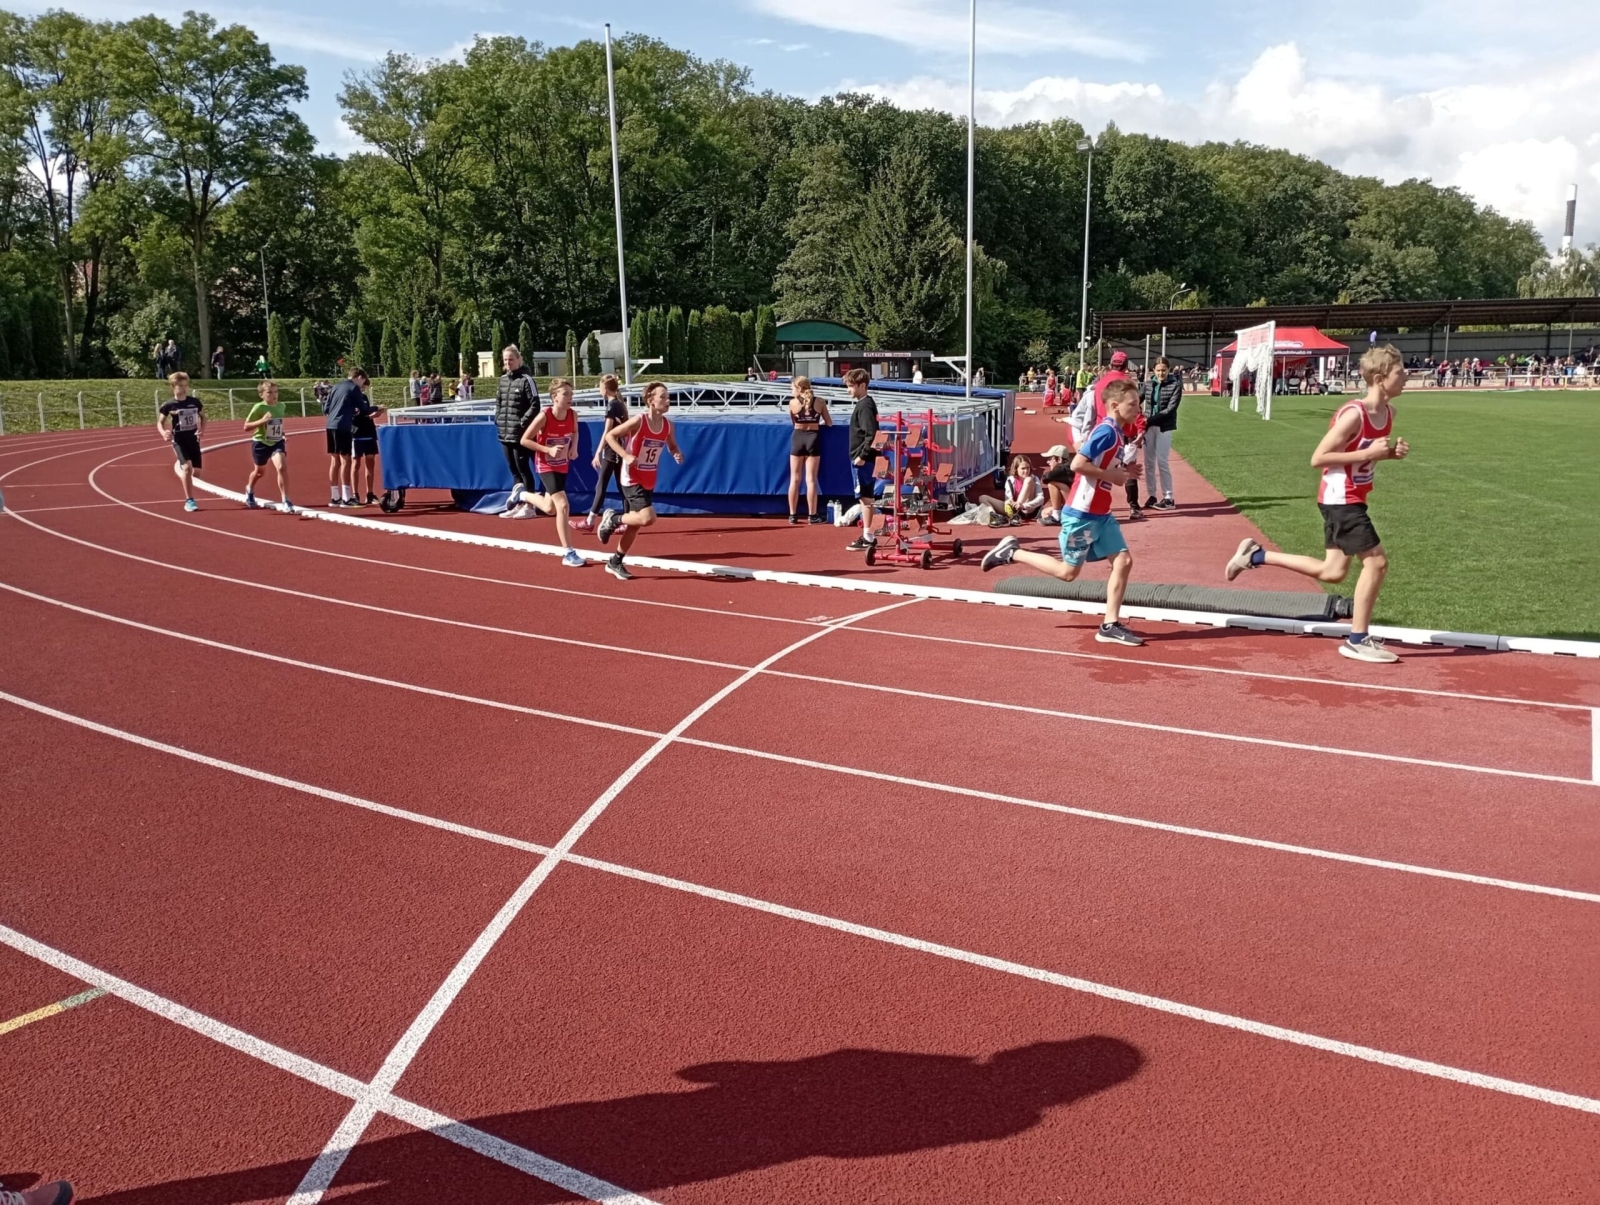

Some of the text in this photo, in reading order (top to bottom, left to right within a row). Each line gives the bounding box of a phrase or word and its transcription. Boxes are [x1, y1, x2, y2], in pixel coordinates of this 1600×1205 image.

[184, 415, 194, 425] 19
[271, 425, 281, 436] 14
[645, 448, 658, 463] 15
